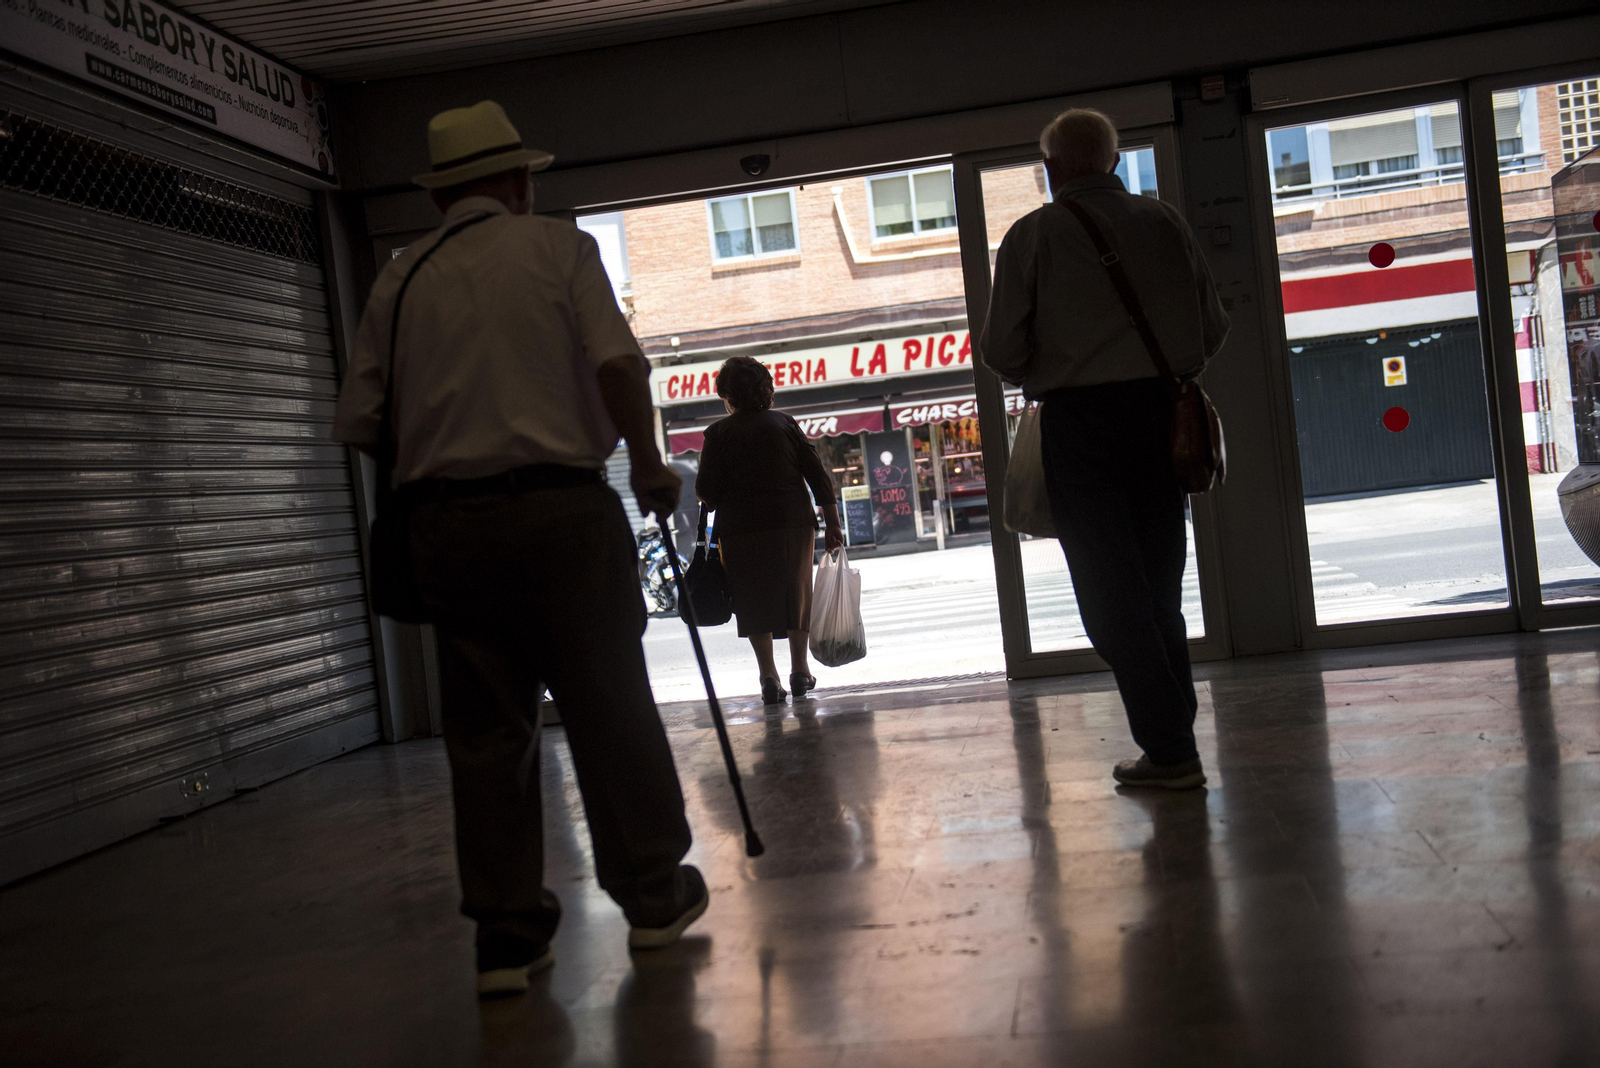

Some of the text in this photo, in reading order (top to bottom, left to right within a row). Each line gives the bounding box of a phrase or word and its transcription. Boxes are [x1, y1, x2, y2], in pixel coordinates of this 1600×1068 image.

[67, 21, 121, 56] medicinales
[128, 44, 190, 86] Complementos
[190, 73, 233, 105] alimenticios
[238, 94, 270, 120] Nutrición
[269, 108, 300, 134] deportiva
[103, 0, 296, 109] SABOR Y SALUD
[90, 58, 215, 120] www.carmensaborysalud.com
[850, 343, 888, 377] LA
[880, 488, 907, 503] LOMO
